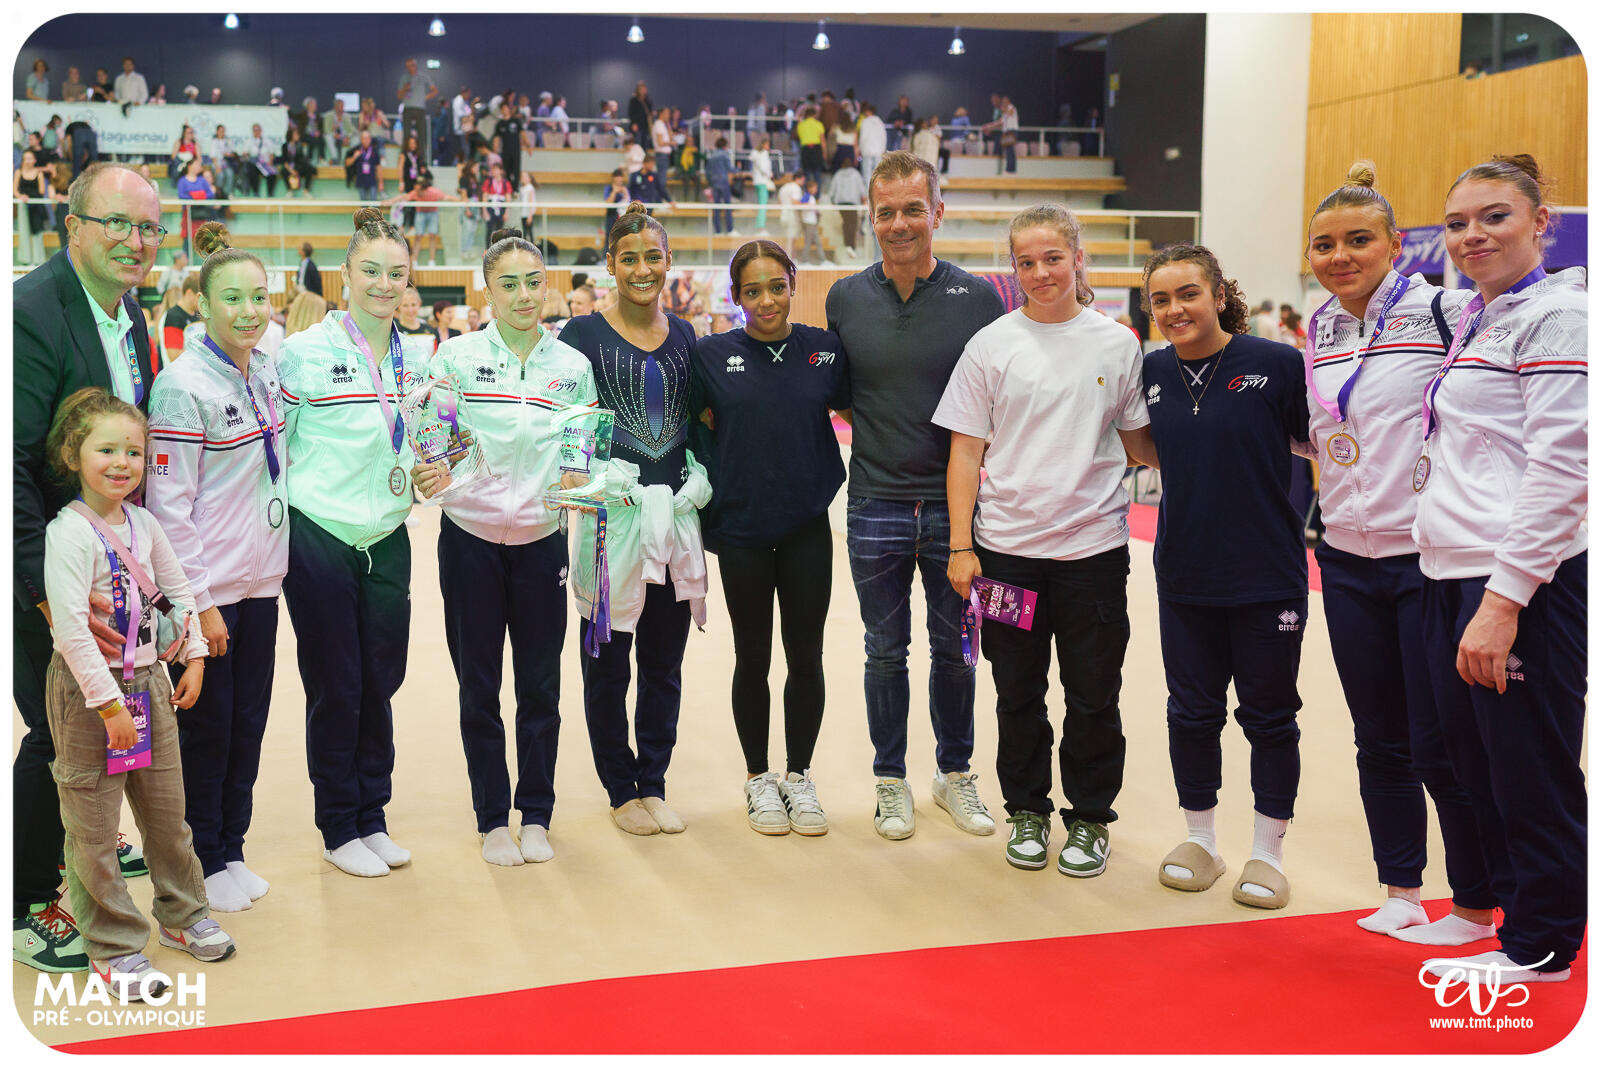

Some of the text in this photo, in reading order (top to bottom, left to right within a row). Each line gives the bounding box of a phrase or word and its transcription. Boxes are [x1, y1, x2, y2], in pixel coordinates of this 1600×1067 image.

[1228, 375, 1268, 392] Gym
[1505, 671, 1525, 681] rea
[124, 758, 136, 766] VIP
